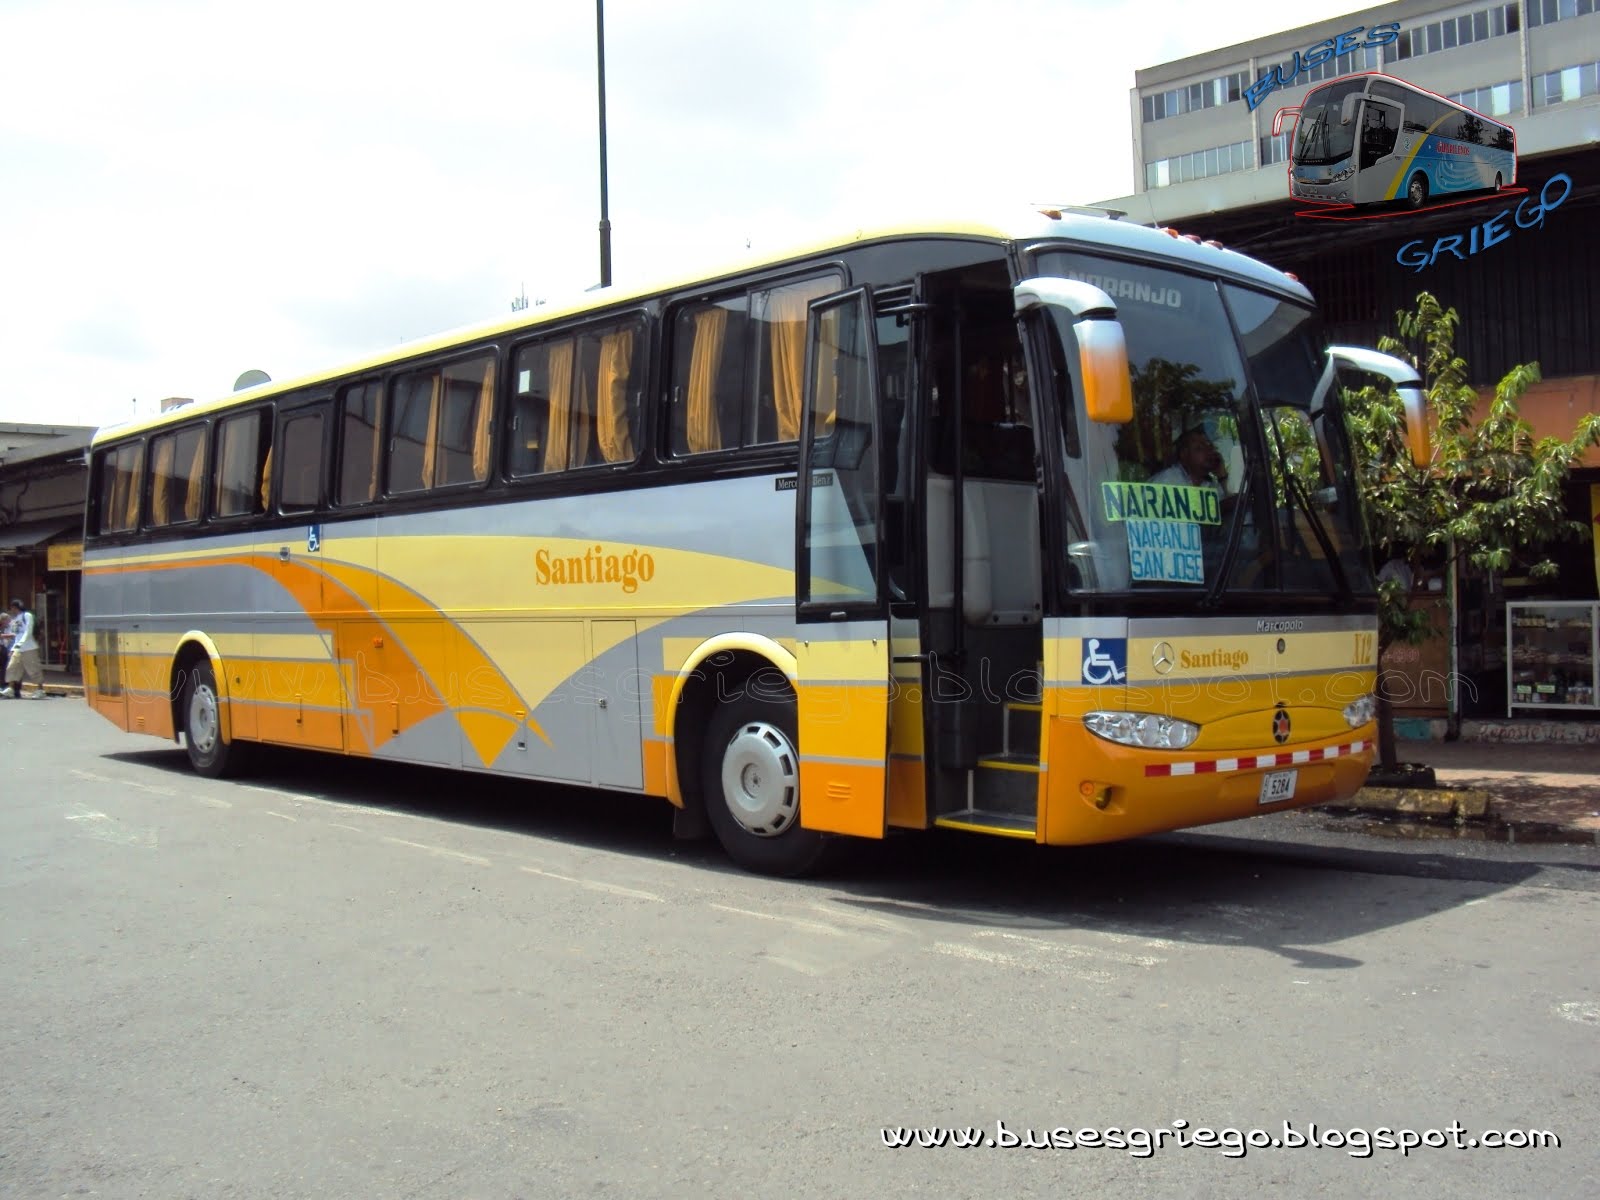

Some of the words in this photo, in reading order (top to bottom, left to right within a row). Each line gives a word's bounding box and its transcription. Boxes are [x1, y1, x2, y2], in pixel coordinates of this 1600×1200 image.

[1104, 484, 1220, 524] NARANJO
[1127, 520, 1200, 551] NARANJO
[535, 545, 655, 594] Santiago
[1132, 550, 1165, 580] SAN
[1168, 552, 1204, 582] JOSE
[1256, 619, 1304, 633] Marcopolo
[1180, 649, 1249, 671] Santiago
